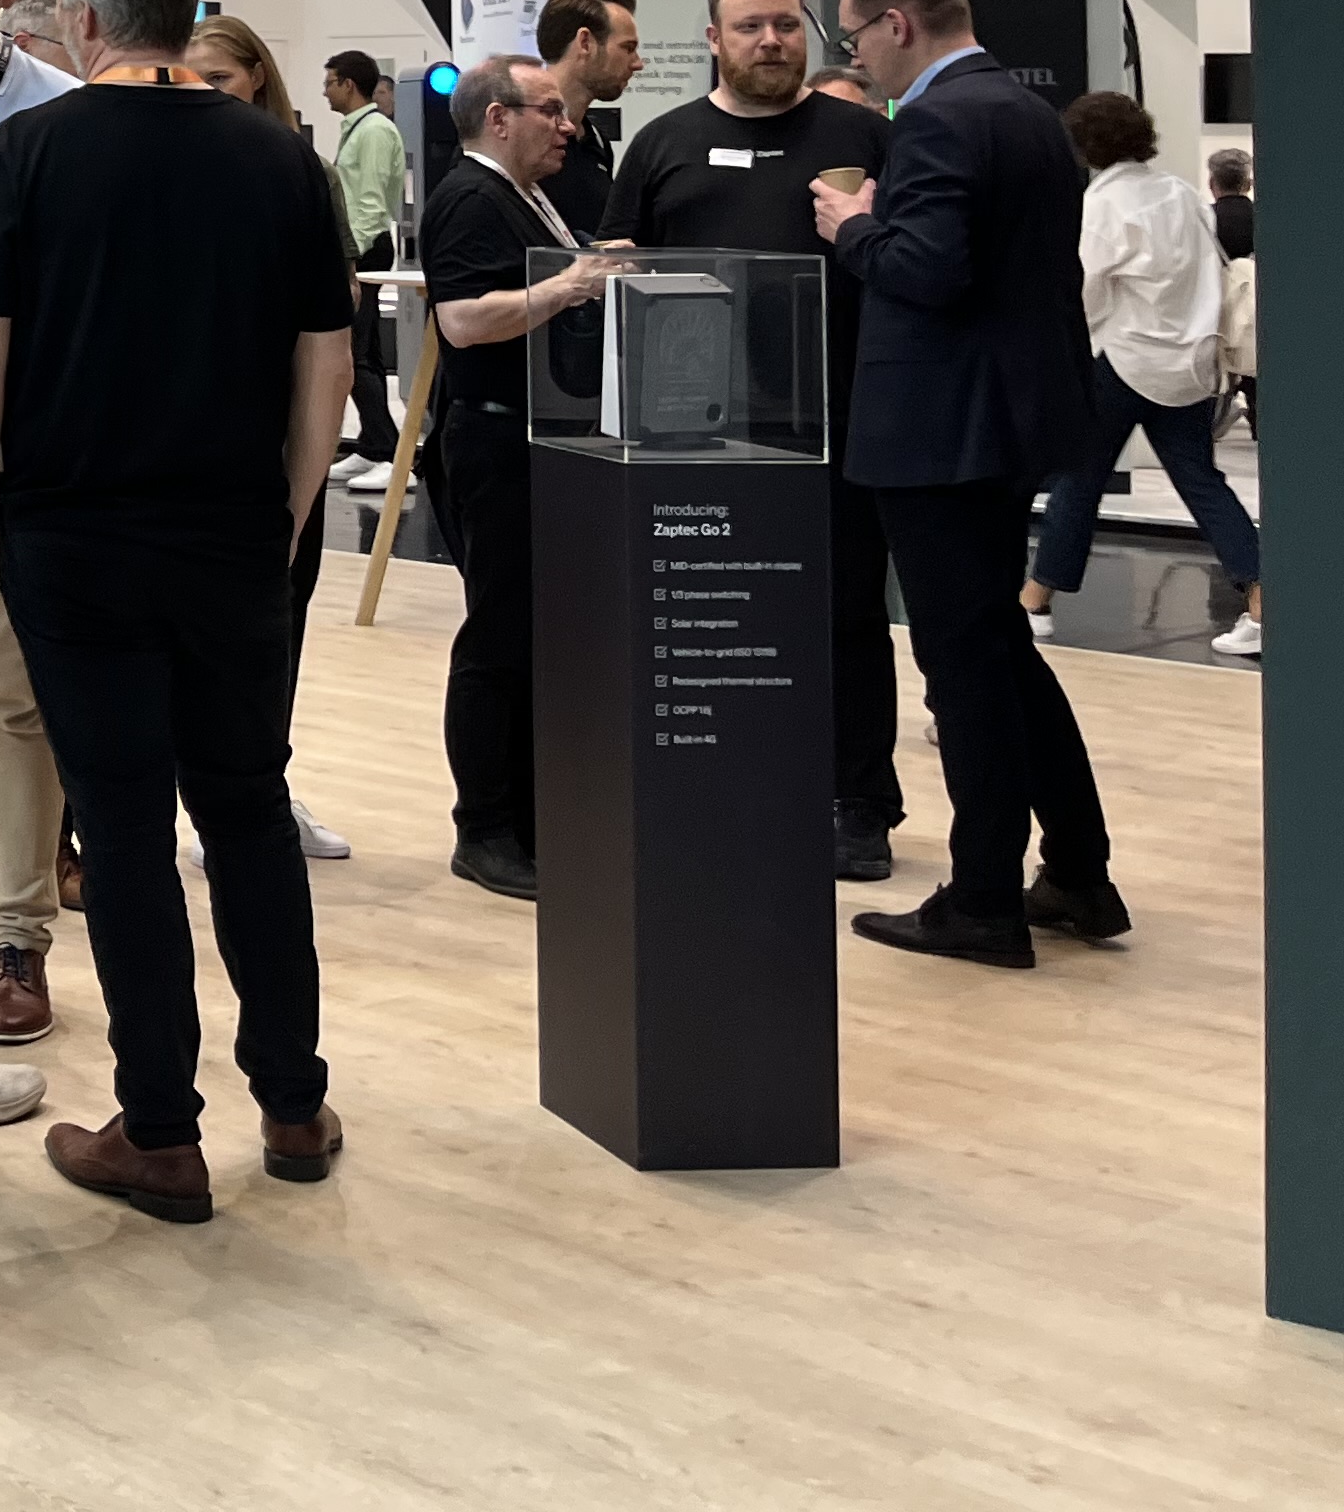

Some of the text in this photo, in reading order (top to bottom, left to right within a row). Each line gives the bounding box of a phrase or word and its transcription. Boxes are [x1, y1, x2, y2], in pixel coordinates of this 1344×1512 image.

[653, 523, 731, 538] Zaptec Go 2
